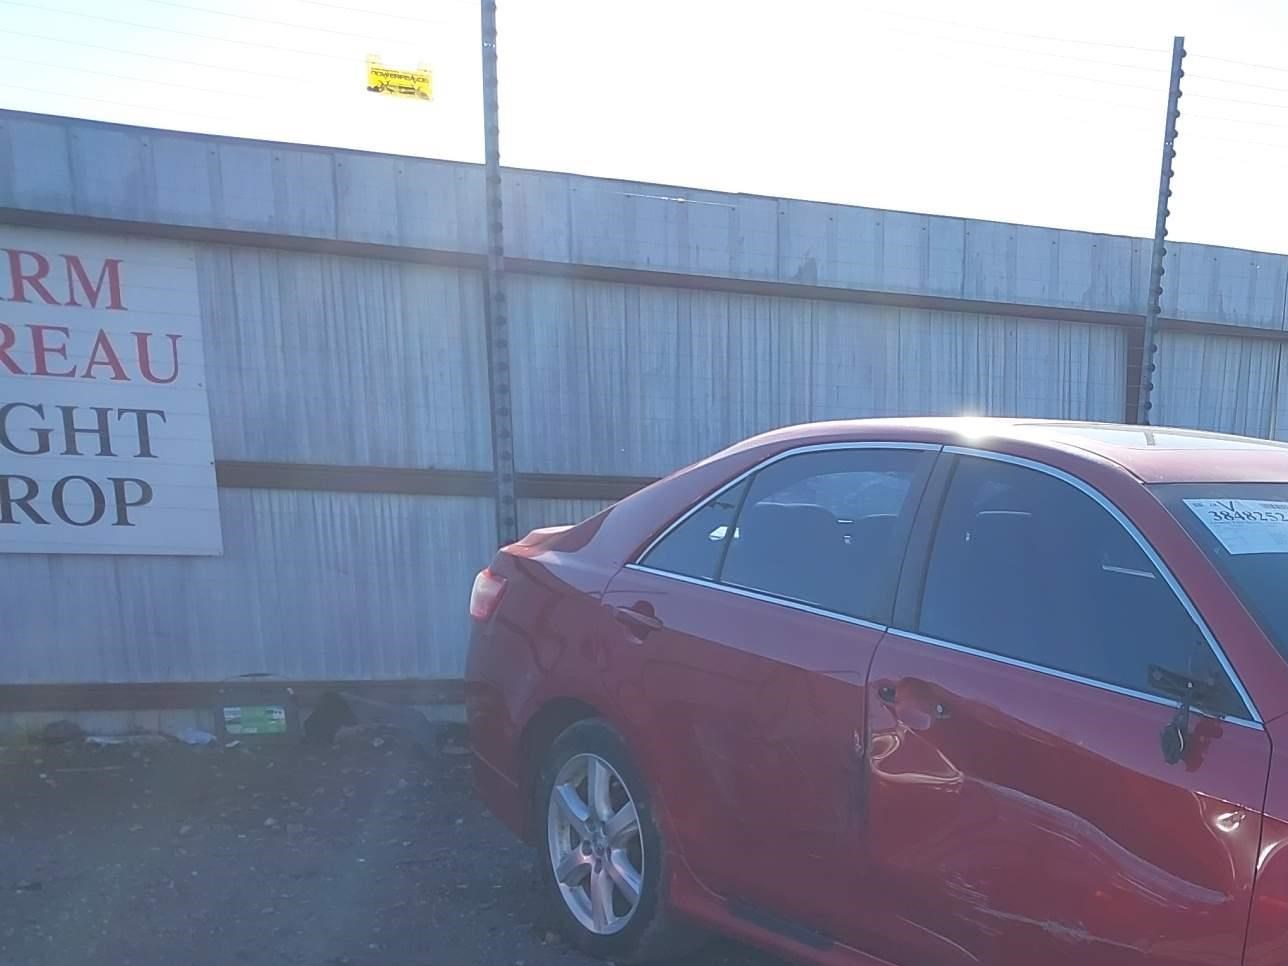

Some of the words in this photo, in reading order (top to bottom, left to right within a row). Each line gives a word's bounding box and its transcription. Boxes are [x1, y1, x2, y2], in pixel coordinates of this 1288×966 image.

[0, 248, 129, 311] RM
[0, 402, 166, 458] GHT
[0, 474, 153, 526] ROP
